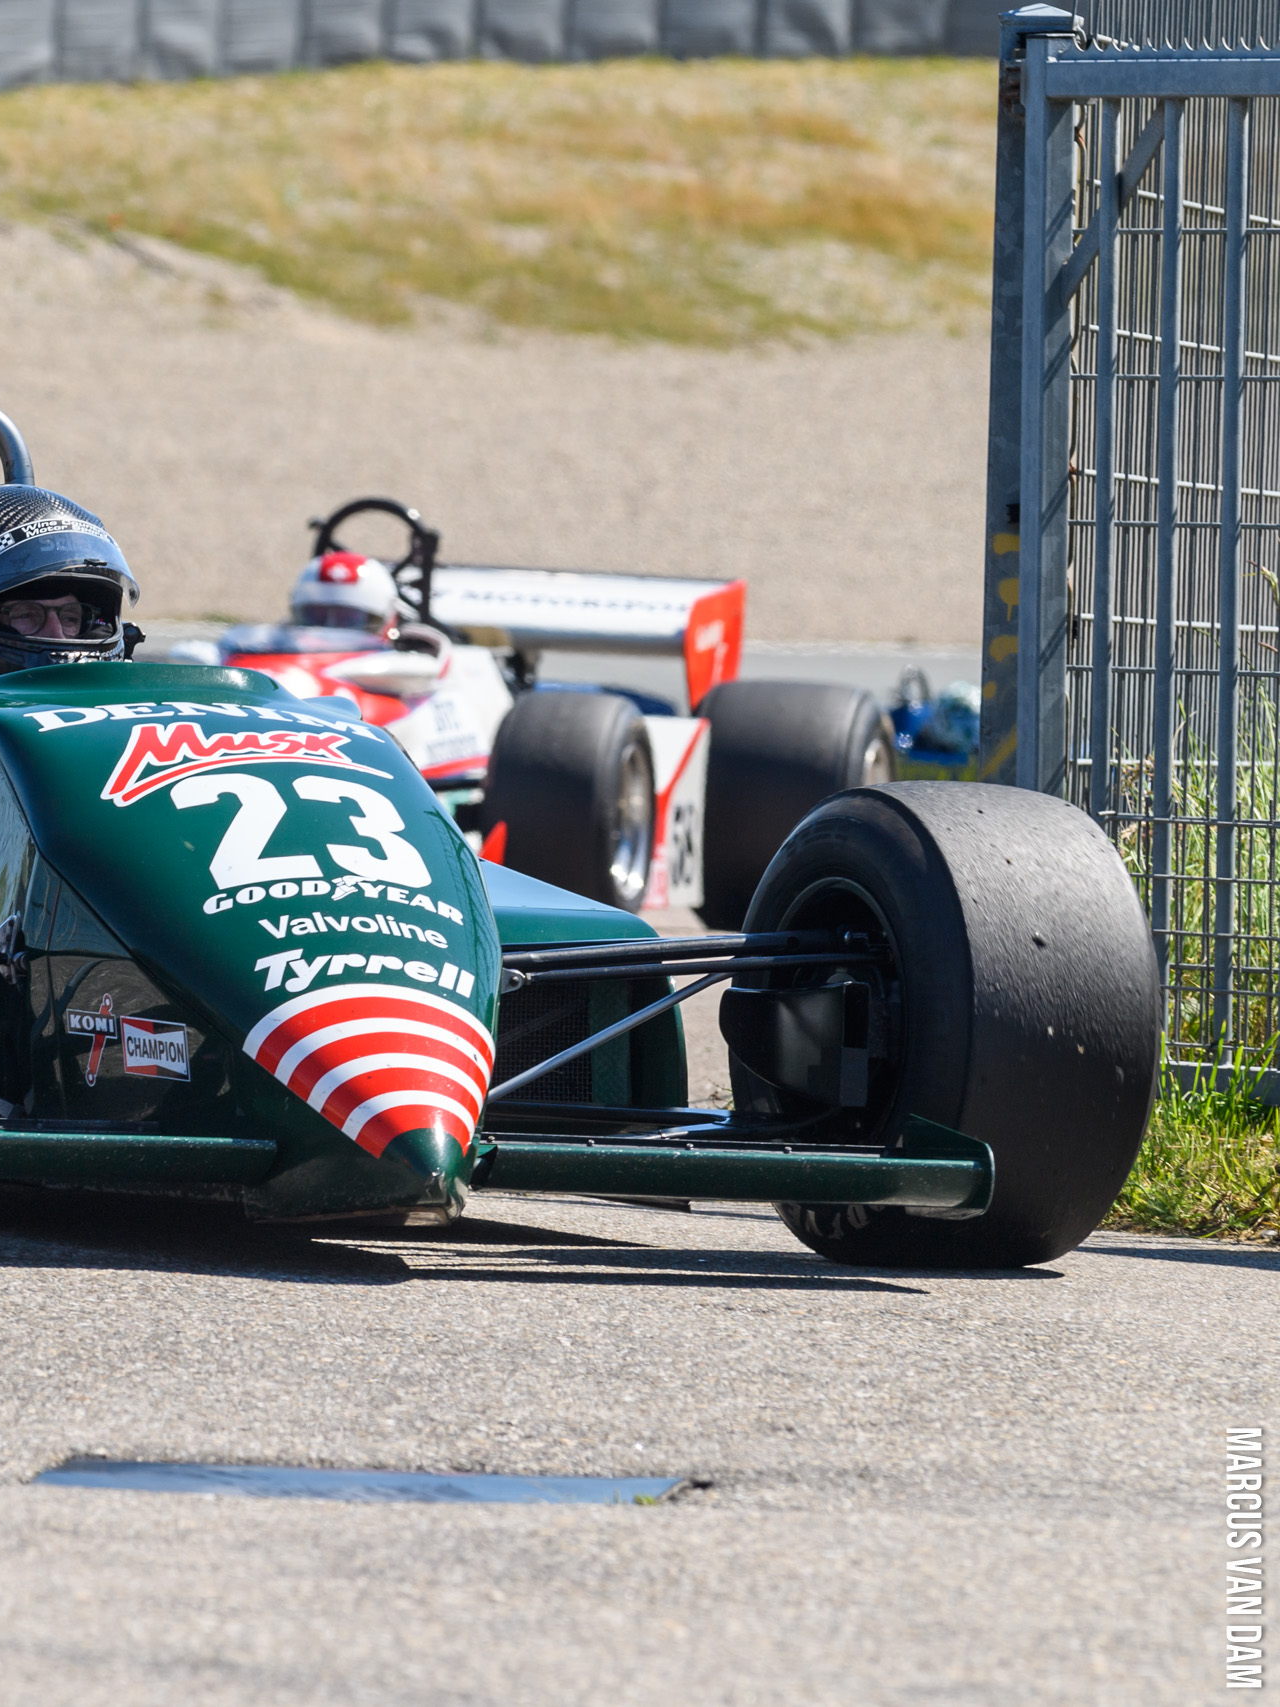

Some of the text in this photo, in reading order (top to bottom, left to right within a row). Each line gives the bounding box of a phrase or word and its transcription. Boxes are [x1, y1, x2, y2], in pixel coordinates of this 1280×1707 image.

[21, 520, 58, 534] Wine
[25, 524, 68, 538] Motor
[23, 701, 386, 743] DENIM
[170, 773, 432, 890] 23
[202, 876, 464, 926] GOODYEAR
[258, 911, 449, 949] Valvoline
[254, 948, 476, 998] Tyrrell
[69, 1013, 115, 1033] KONI
[126, 1035, 185, 1063] CHAMPION
